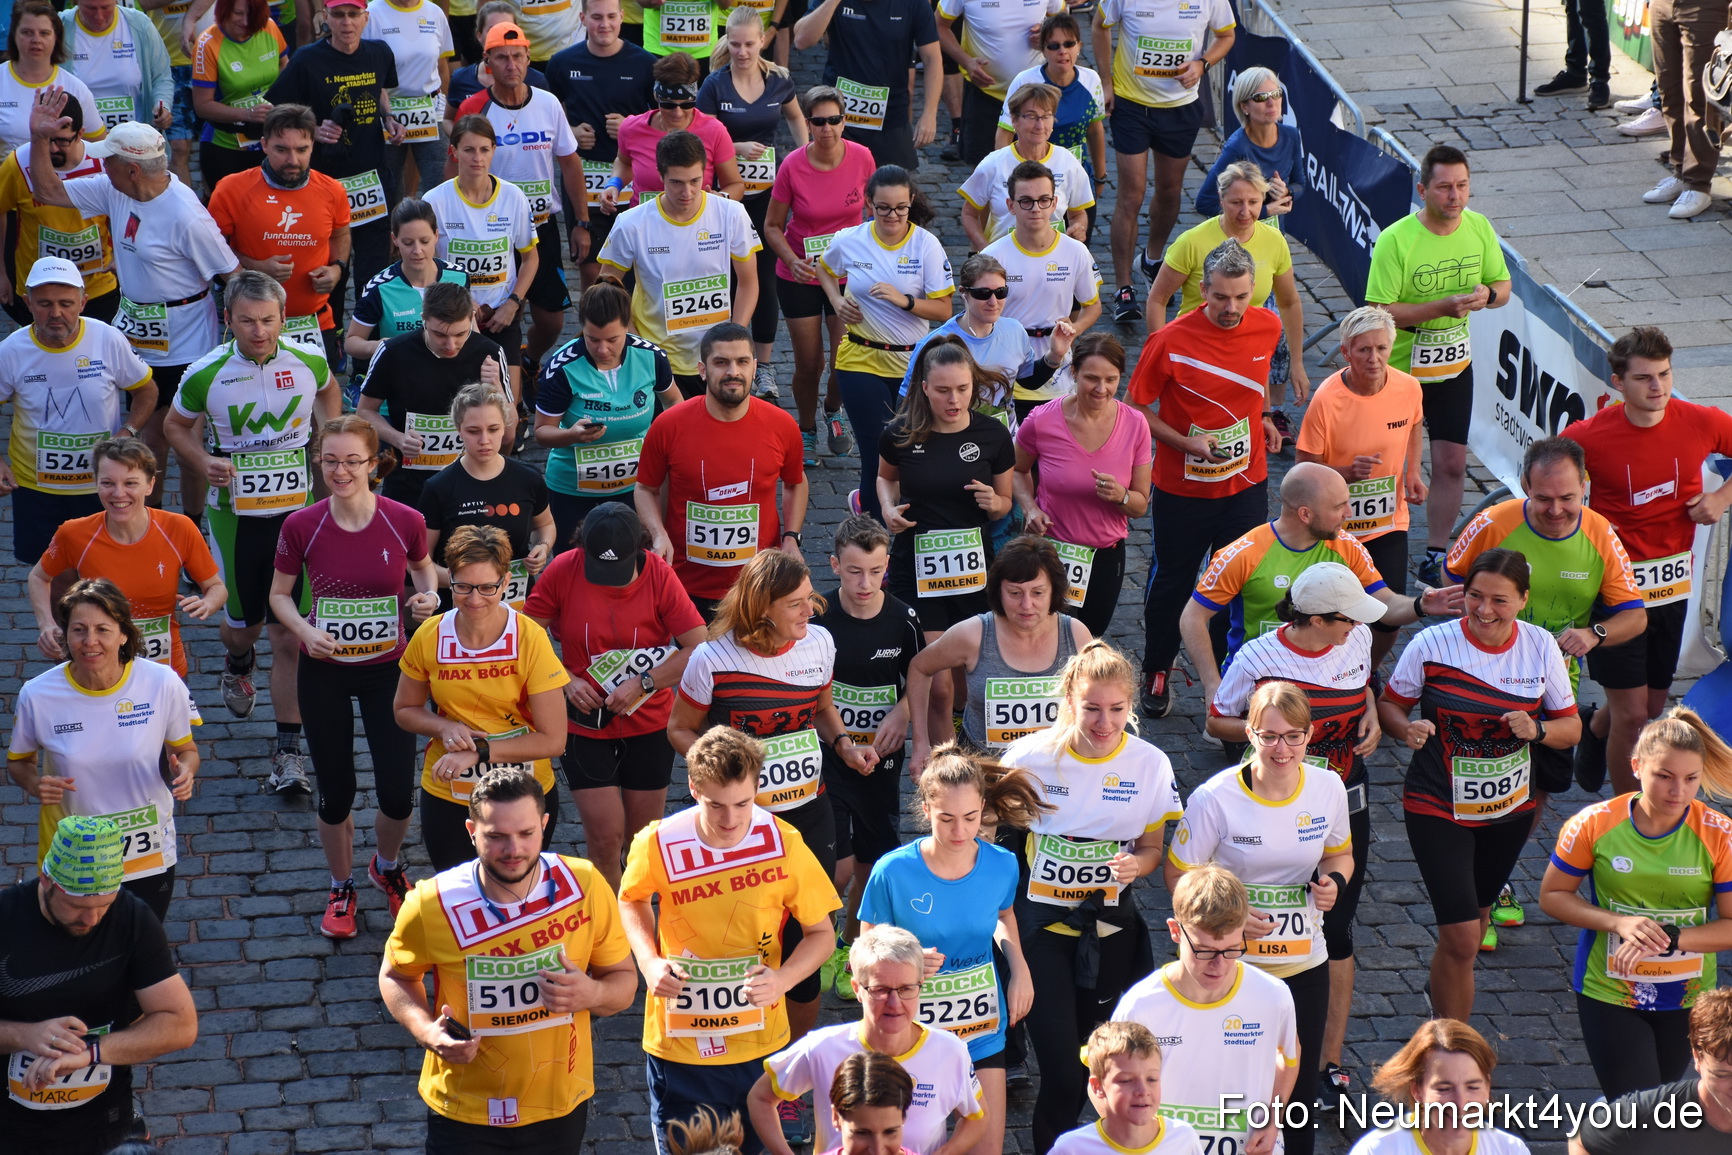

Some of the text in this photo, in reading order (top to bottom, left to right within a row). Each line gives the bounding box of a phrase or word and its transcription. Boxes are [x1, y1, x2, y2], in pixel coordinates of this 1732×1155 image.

[665, 4, 706, 13] BOCK
[667, 18, 706, 32] 5218
[667, 34, 706, 42] MATTHIAS
[1142, 38, 1187, 50] BOCK
[1141, 52, 1185, 66] 5238
[841, 81, 883, 98] BOCK
[738, 164, 769, 180] 222
[43, 230, 96, 246] BOCK
[263, 232, 312, 240] funrunners
[277, 238, 318, 246] neumarkt
[698, 232, 709, 240] 20
[453, 240, 503, 252] BOCK
[46, 245, 95, 262] 5099
[455, 255, 502, 272] 5043
[668, 277, 721, 295] BOCK
[672, 293, 723, 316] 5246
[117, 315, 162, 337] 5235
[1419, 330, 1465, 344] BOCK
[1419, 343, 1465, 364] 5283
[77, 358, 89, 367] 20
[221, 375, 254, 386] smartblock
[584, 400, 612, 411] H&S
[1387, 418, 1408, 430] THULE
[1495, 402, 1533, 450] stadtwe
[44, 434, 104, 448] BOCK
[254, 431, 300, 447] ENERGIE
[583, 443, 637, 461] BOCK
[45, 453, 90, 470] 524
[241, 455, 297, 469] BOCK
[415, 455, 446, 466] DAVID
[44, 473, 93, 481] FRANZ-XAV
[586, 461, 639, 479] 5167
[242, 471, 300, 494] 5279
[601, 481, 625, 489] LISA
[719, 486, 738, 496] DEHN
[1645, 488, 1664, 500] DEHN
[1351, 497, 1388, 518] 161
[692, 508, 751, 522] BOCK
[1346, 520, 1378, 530] ANITA
[694, 526, 751, 546] 5179
[920, 534, 978, 550] BOCK
[1451, 511, 1494, 564] BOCK
[707, 550, 737, 560] SAAD
[924, 552, 980, 576] 5118
[1203, 537, 1255, 591] BOCK
[1561, 571, 1590, 580] BOCK
[1634, 559, 1685, 586] 5186
[928, 576, 979, 590] MARLENE
[1649, 587, 1674, 599] NICO
[323, 601, 389, 616] BOCK
[326, 620, 389, 641] 5062
[333, 644, 383, 656] NATALIE
[438, 665, 519, 681] MAX BÖGL
[1500, 677, 1540, 685] NEUMARKT
[118, 701, 133, 713] 20
[995, 702, 1058, 725] 5010
[118, 710, 155, 720] Neumarkter
[839, 707, 887, 729] 089
[54, 723, 83, 732] BOCK
[118, 718, 148, 727] Stadtlauf
[884, 759, 894, 770] 49
[1460, 752, 1525, 775] BOCK
[758, 757, 815, 789] 5086
[1104, 777, 1120, 788] 20
[1464, 768, 1523, 800] 5087
[771, 788, 805, 803] ANITA
[1102, 795, 1132, 803] Stadtlauf
[1103, 788, 1140, 796] Neumarkter
[1477, 796, 1516, 814] JANET
[1297, 816, 1311, 826] 20
[1298, 824, 1330, 834] Neumarkter
[1233, 836, 1262, 844] BOCK
[1299, 832, 1325, 842] Stadtlauf
[1049, 840, 1114, 860] BOCK
[1041, 859, 1112, 885] 5069
[1669, 867, 1703, 876] BOCK
[671, 866, 789, 906] MAX BÖGL
[1054, 889, 1093, 900] LINDA
[530, 909, 592, 948] BÖGL
[1259, 944, 1288, 954] LISA
[476, 955, 554, 977] BOCK
[920, 972, 988, 997] BOCK
[480, 982, 539, 1009] 510
[919, 993, 990, 1025] 5226
[491, 1010, 550, 1027] SIEMON
[690, 1016, 739, 1028] JONAS
[1225, 1019, 1242, 1030] 20
[1224, 1030, 1264, 1038] Neumarkter
[1224, 1038, 1257, 1046] Stadtlauf
[29, 1089, 79, 1104] MARC
[1198, 1136, 1238, 1155] 70
